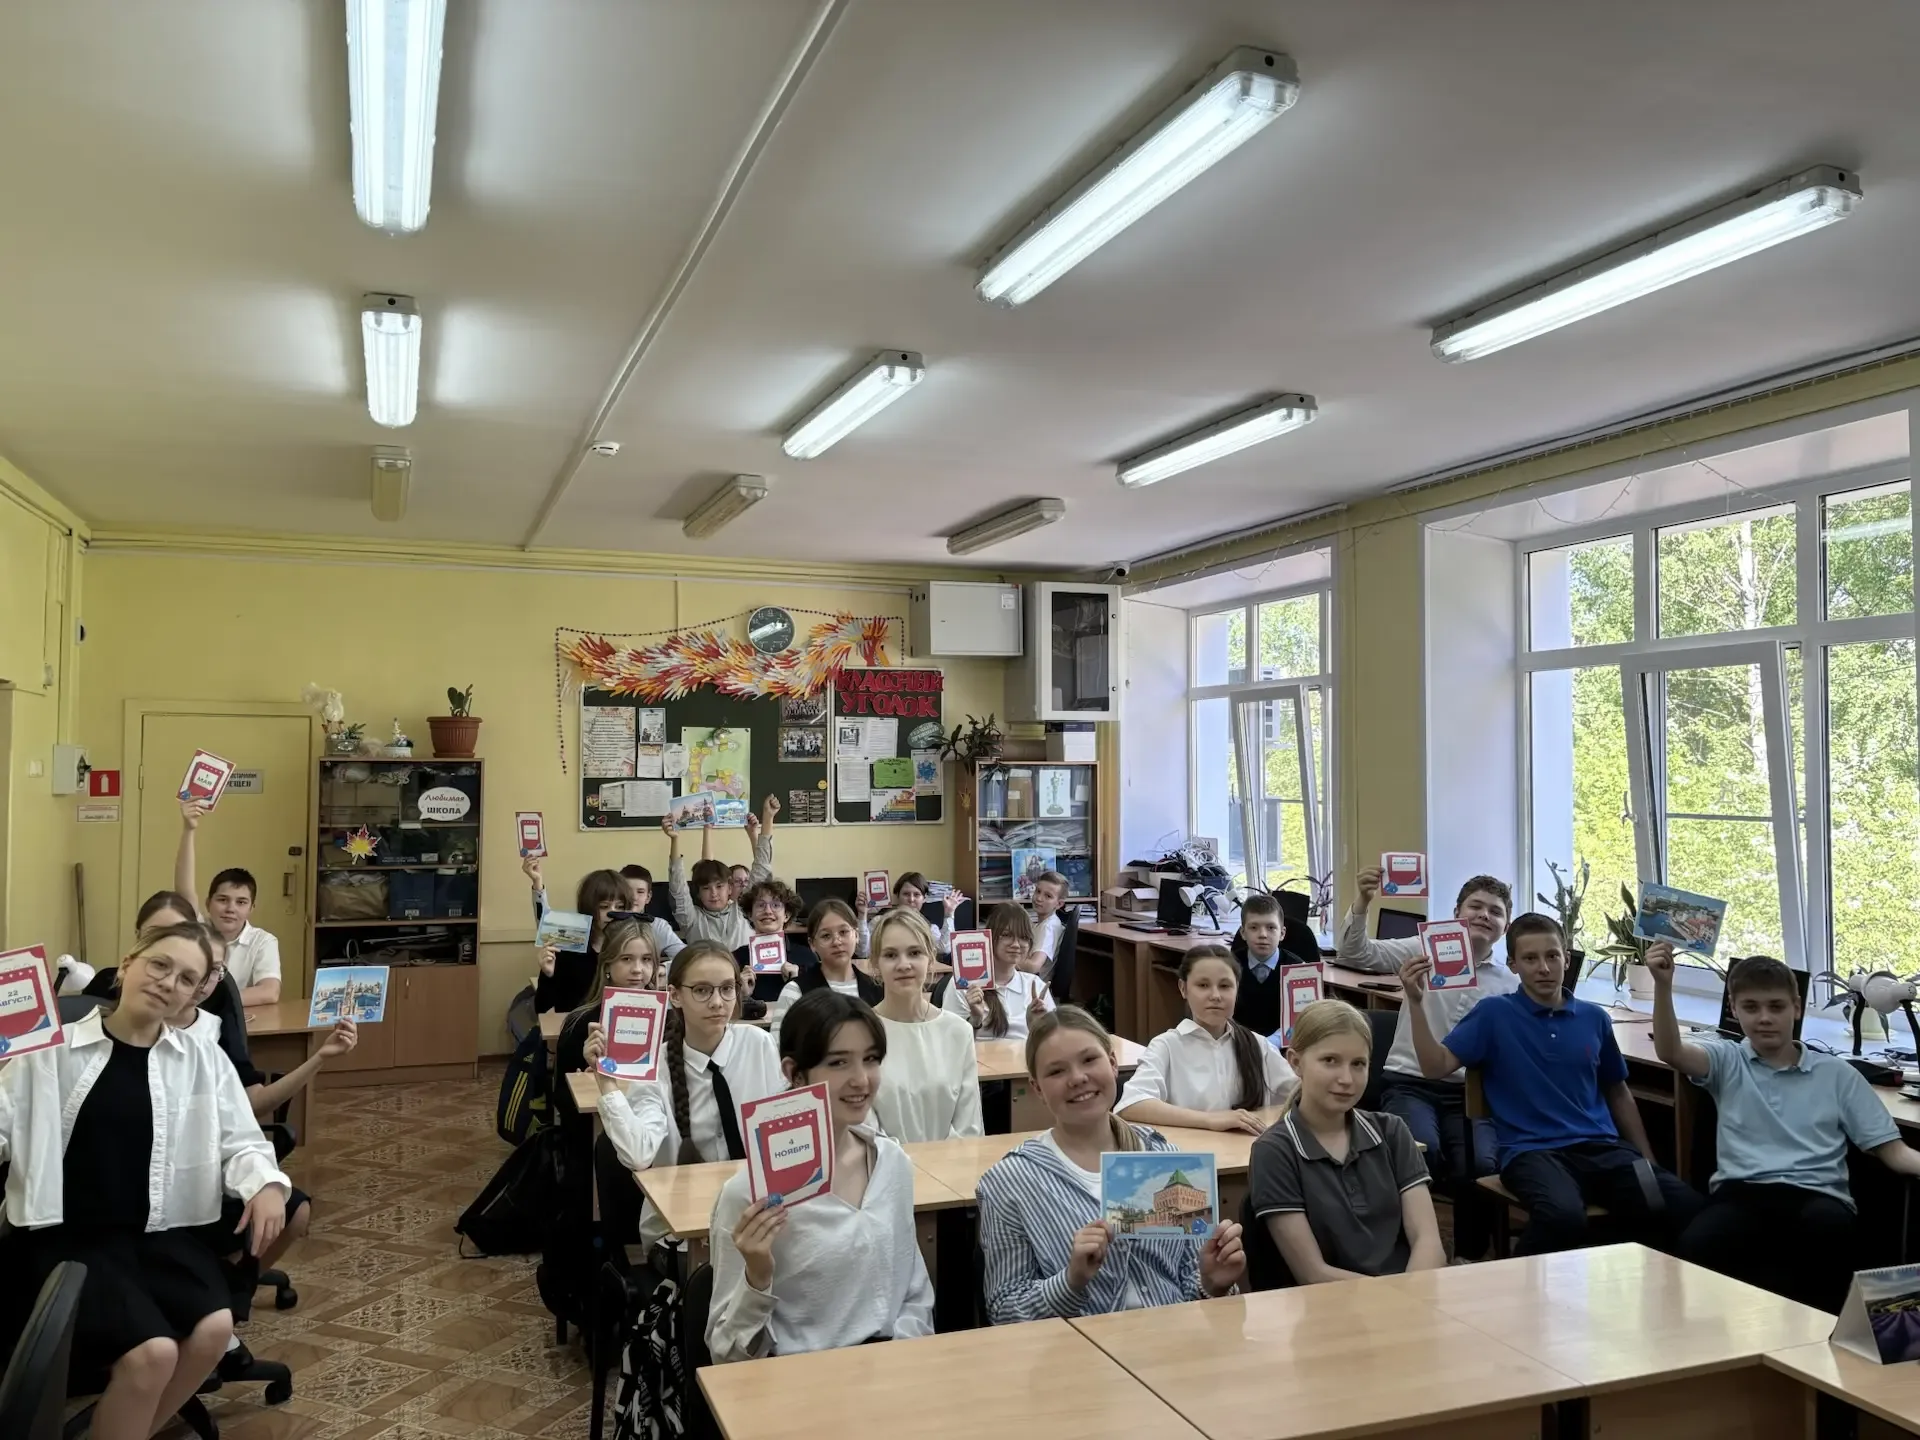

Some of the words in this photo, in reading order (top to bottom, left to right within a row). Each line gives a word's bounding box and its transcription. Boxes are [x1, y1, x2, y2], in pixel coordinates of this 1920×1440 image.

[841, 692, 939, 718] УГОЛОК
[196, 776, 213, 786] МАЯ
[424, 794, 465, 802] Любимая
[7, 989, 19, 998] 22
[774, 1144, 810, 1159] НОЯБРЯ
